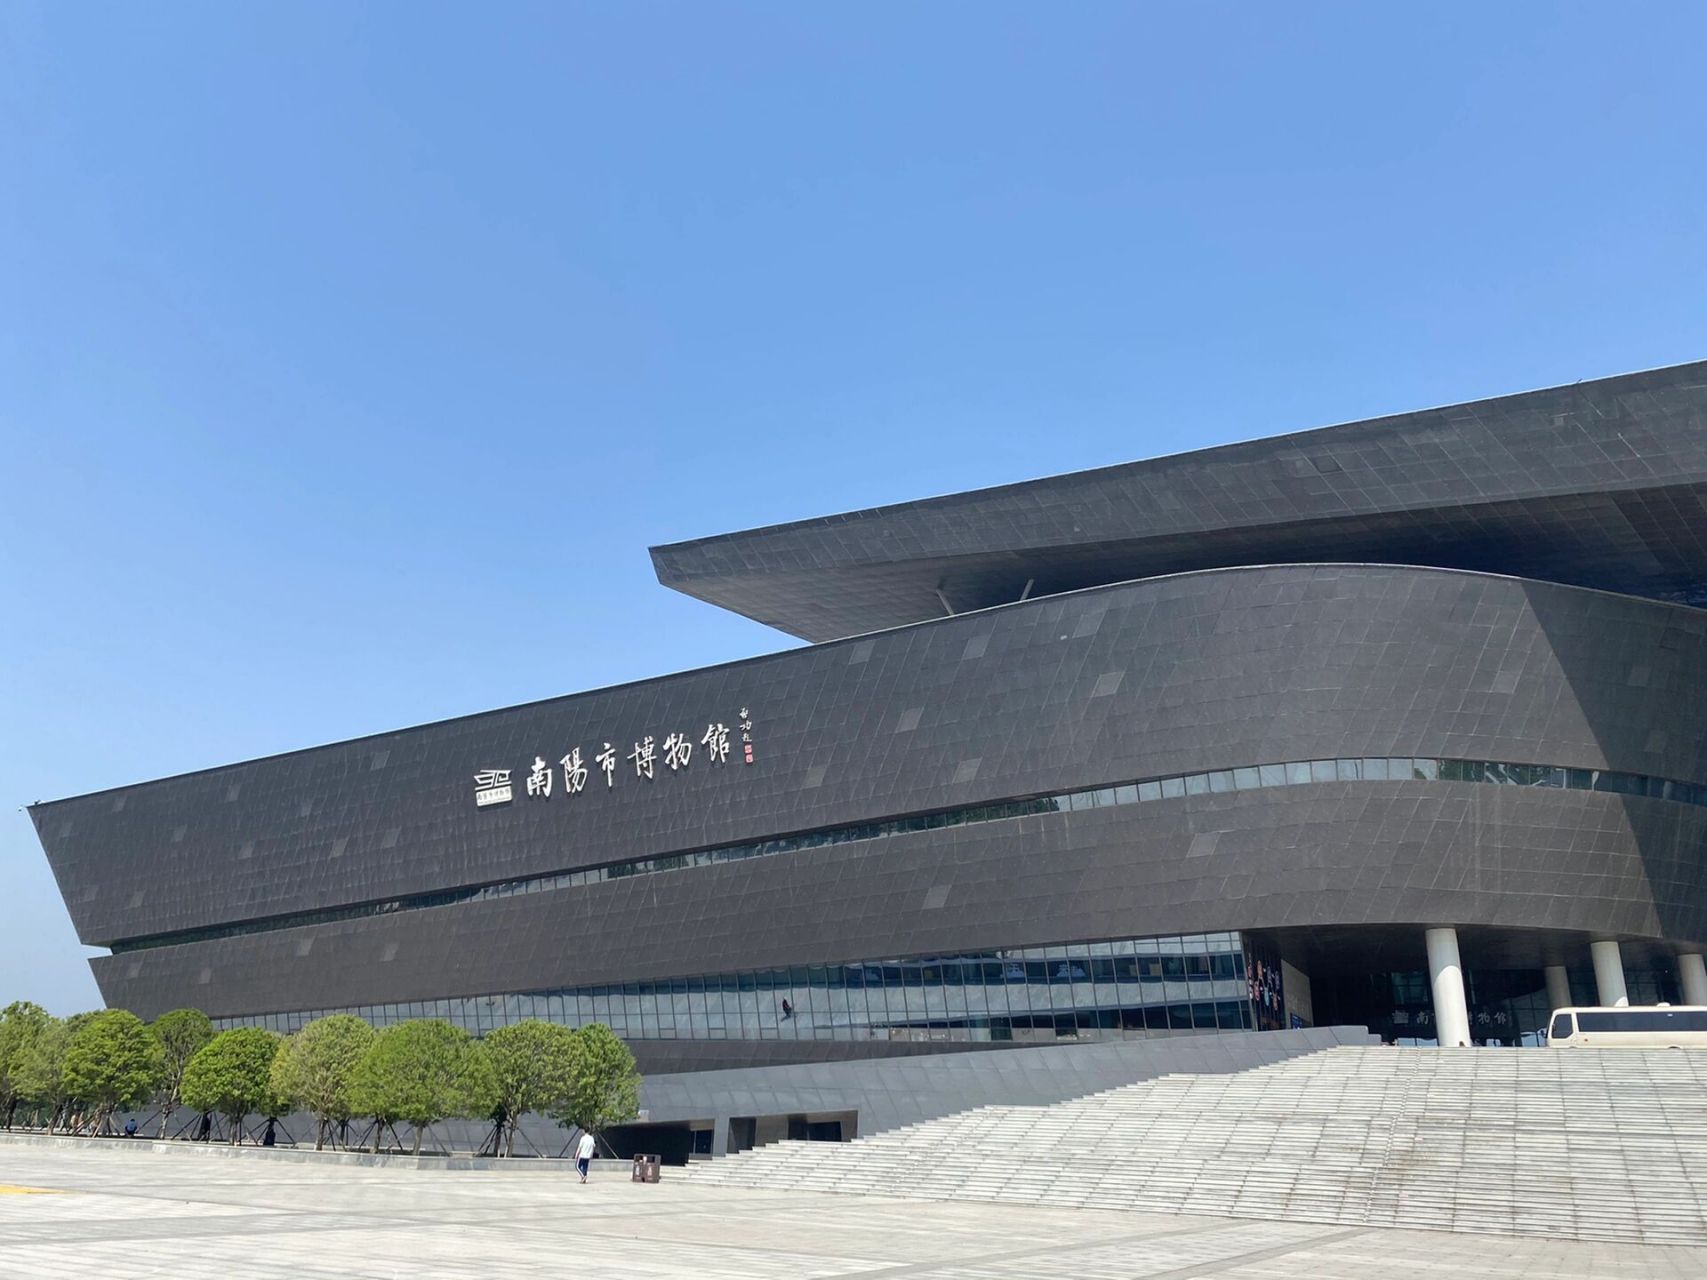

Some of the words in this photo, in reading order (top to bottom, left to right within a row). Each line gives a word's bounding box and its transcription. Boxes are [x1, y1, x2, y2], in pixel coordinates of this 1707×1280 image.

[526, 723, 730, 798] 南陽市博物館
